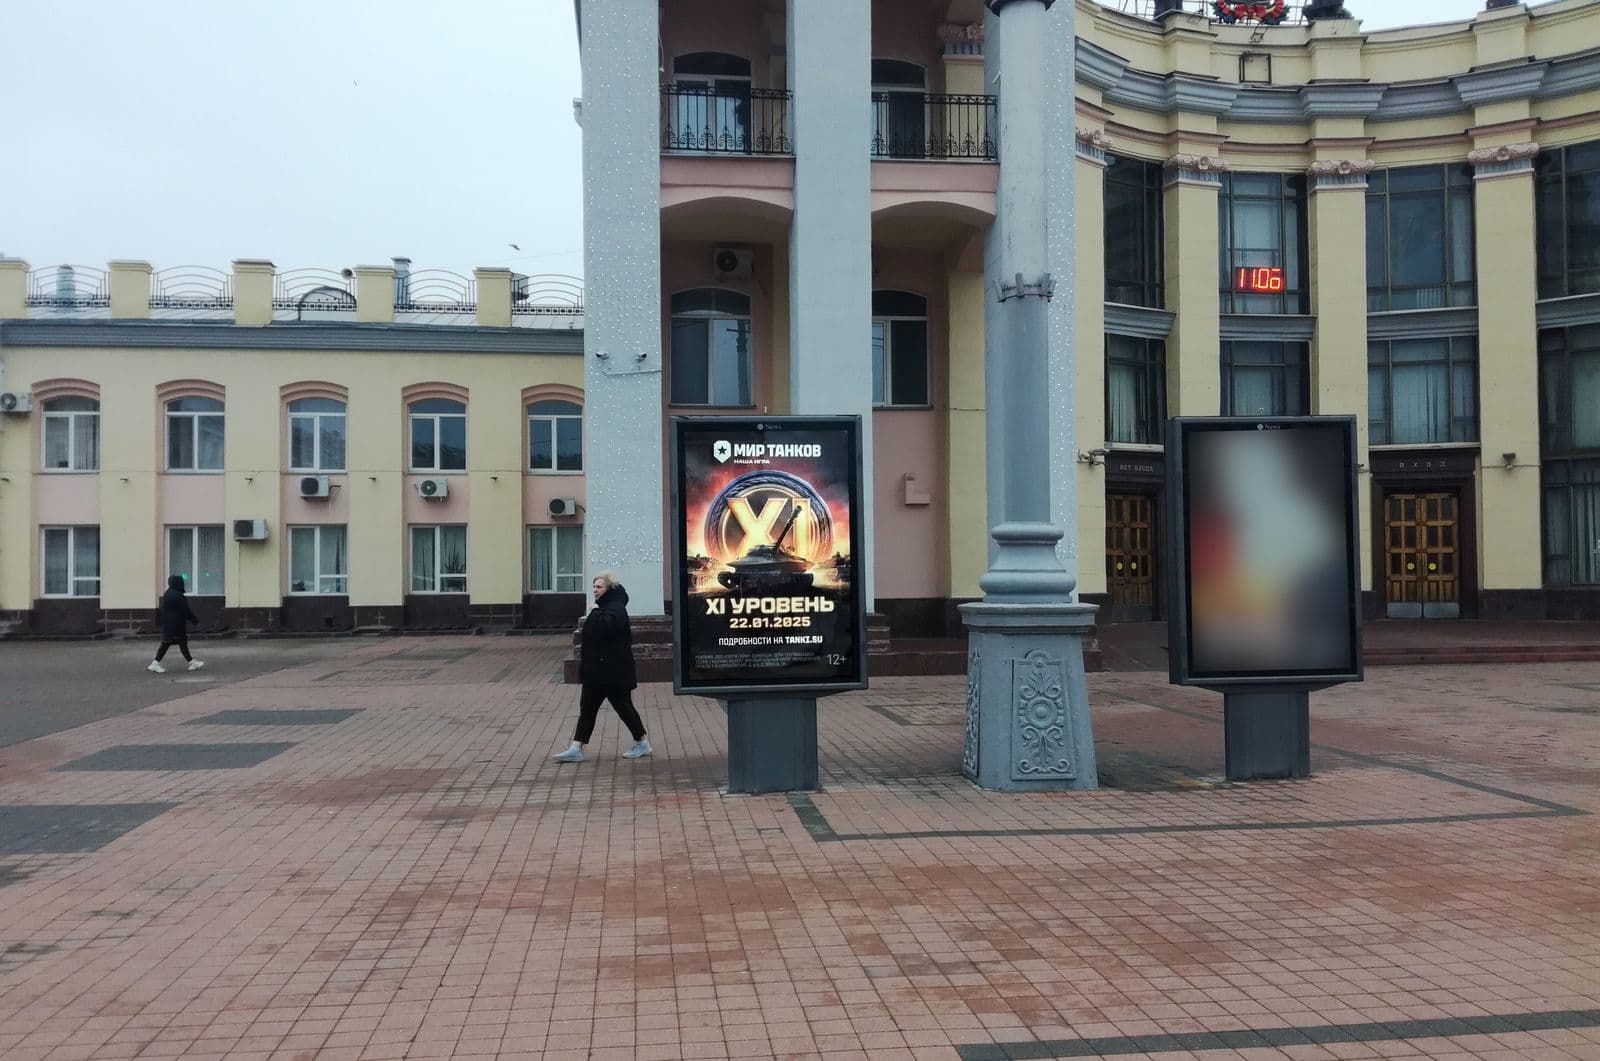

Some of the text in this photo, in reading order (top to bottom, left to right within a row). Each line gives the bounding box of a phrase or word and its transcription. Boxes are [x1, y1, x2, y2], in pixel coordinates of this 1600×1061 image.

[1240, 268, 1281, 289] 11.06
[733, 444, 822, 458] МИР ТАНКОВ
[726, 497, 812, 560] XI
[705, 596, 835, 615] XI УРОВЕНЬ
[729, 616, 811, 629] 22.01.2025
[718, 635, 823, 647] ПОДРОБНОСТИ НА TANKI.SU
[826, 653, 847, 666] 12+
